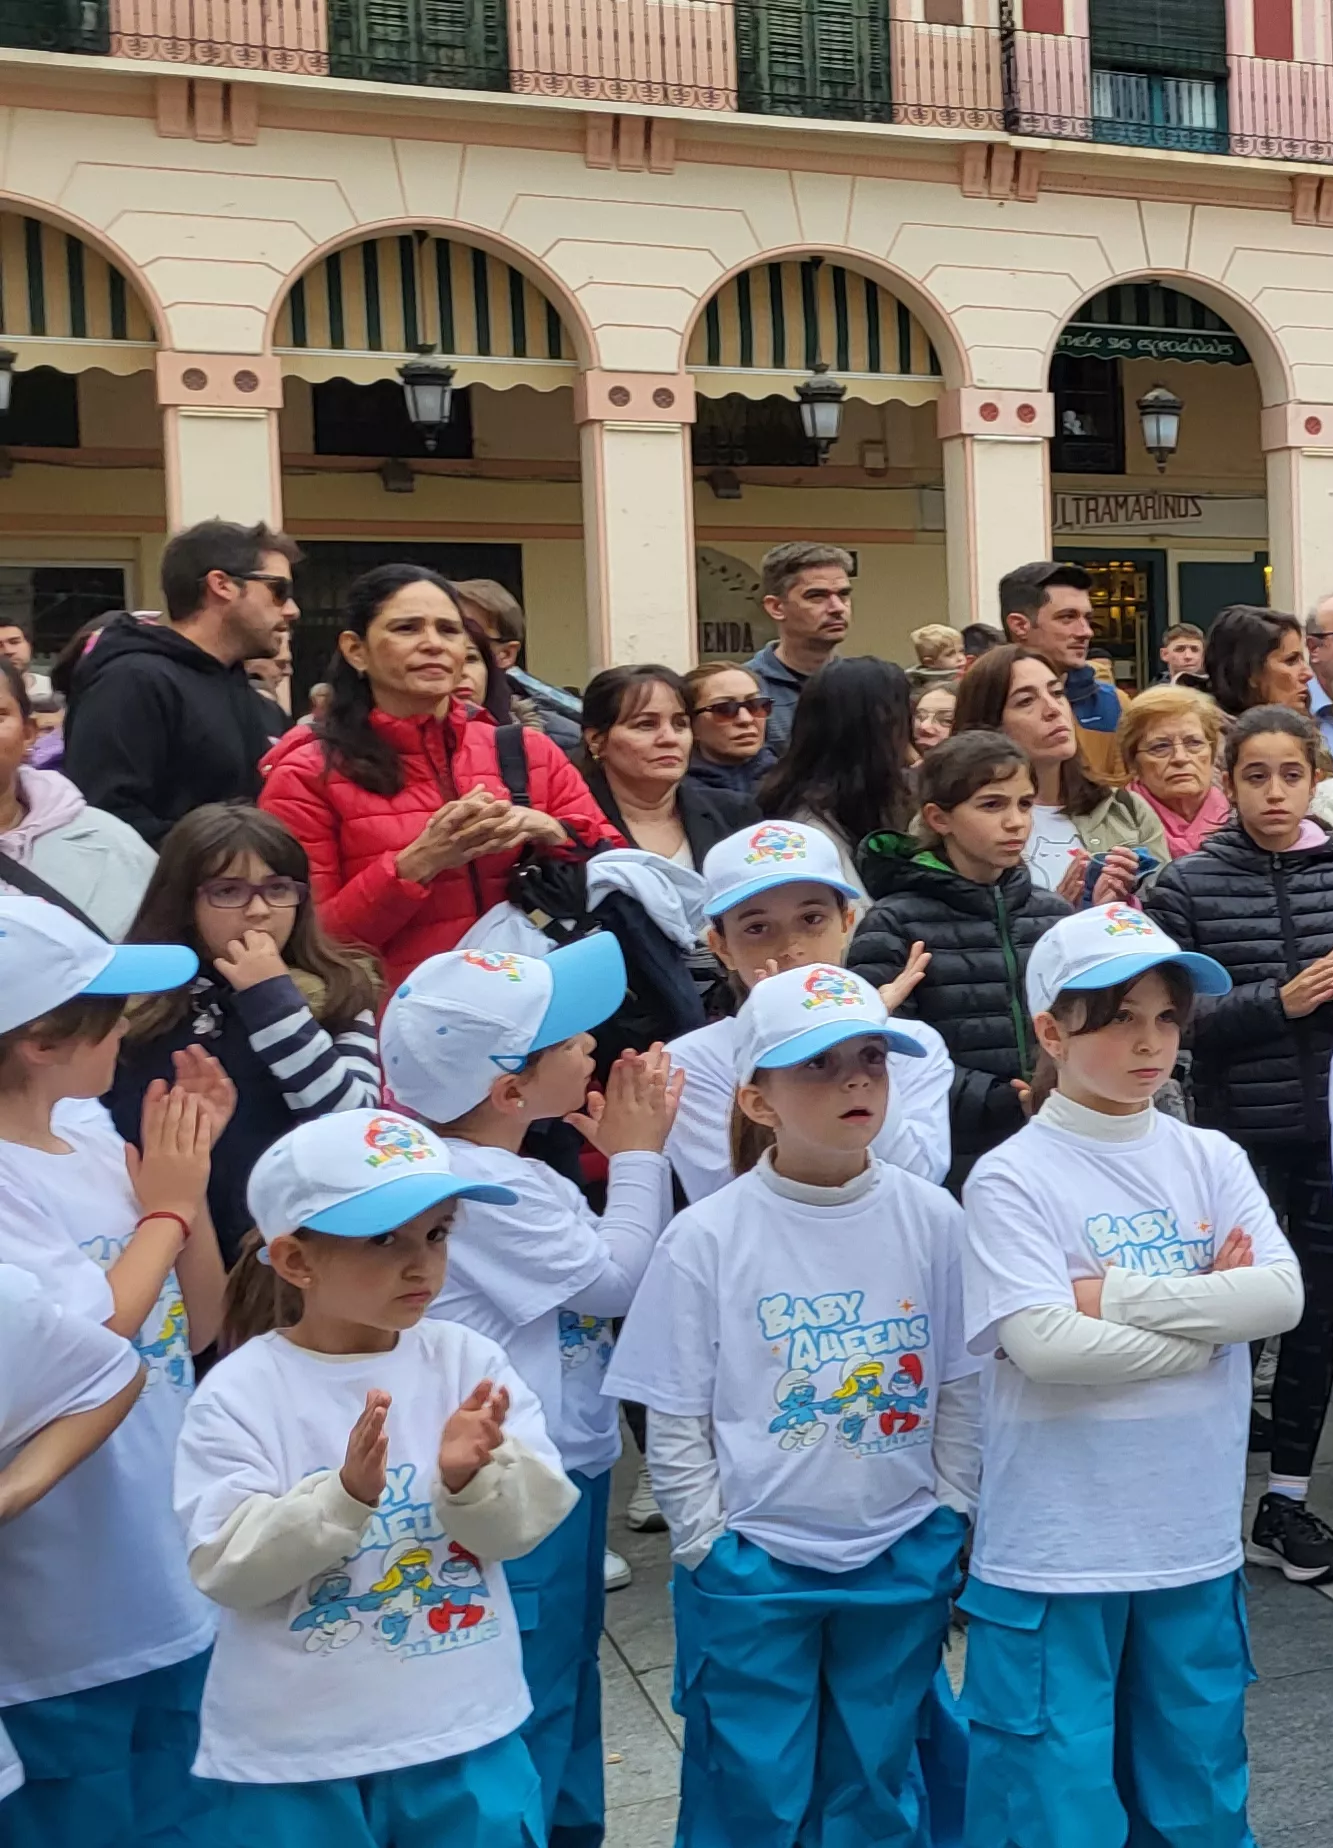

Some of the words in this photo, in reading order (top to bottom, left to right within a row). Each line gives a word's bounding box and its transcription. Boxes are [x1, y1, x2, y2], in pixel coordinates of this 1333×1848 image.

[1108, 336, 1132, 350] sus
[1085, 1206, 1178, 1257] BABY
[757, 1290, 864, 1341] BABY
